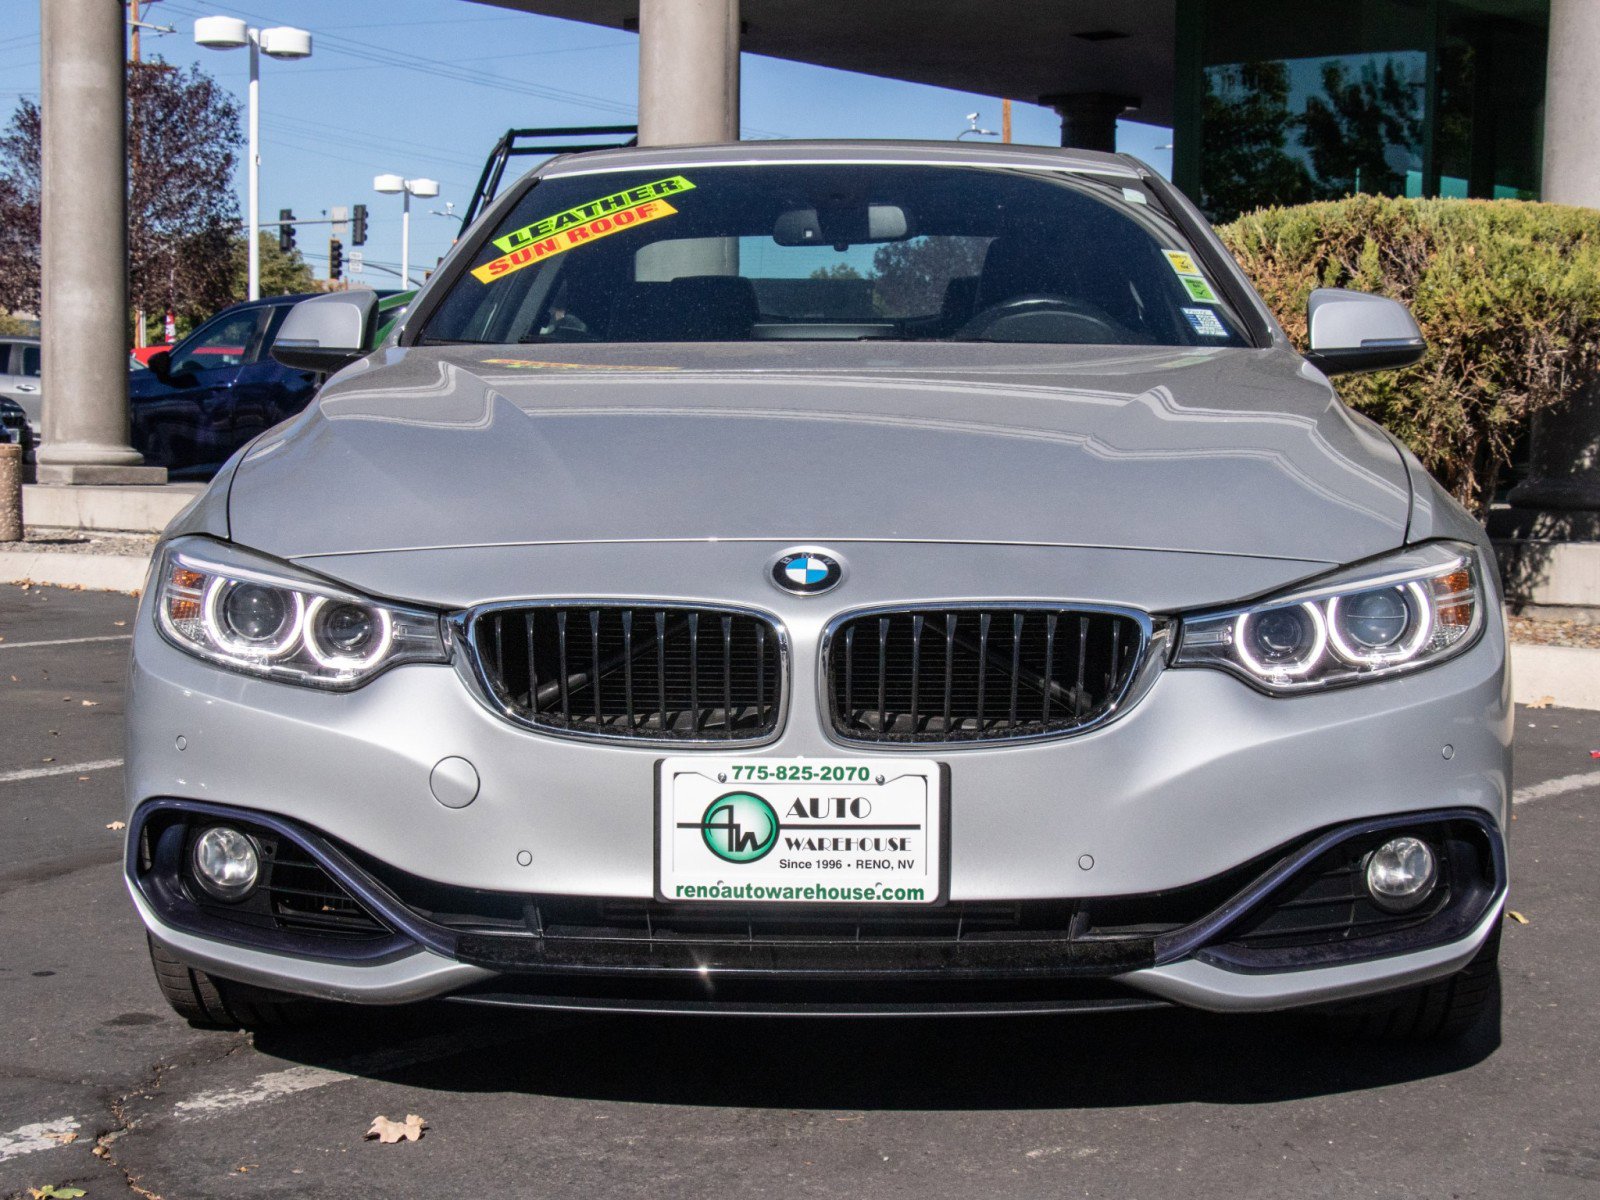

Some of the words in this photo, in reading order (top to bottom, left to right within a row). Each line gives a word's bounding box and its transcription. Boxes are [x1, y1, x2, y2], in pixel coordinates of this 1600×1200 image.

[507, 179, 679, 248] LEATHER
[488, 238, 557, 276] SUN
[566, 203, 656, 243] ROOF
[731, 765, 870, 782] 775-825-2070
[785, 796, 872, 819] AUTO
[784, 836, 912, 852] WAREHOUSE
[779, 858, 812, 870] Since
[815, 859, 843, 870] 1996
[855, 859, 894, 872] RENO,
[897, 859, 915, 870] NV
[675, 883, 925, 901] renoautowarehouse.com
